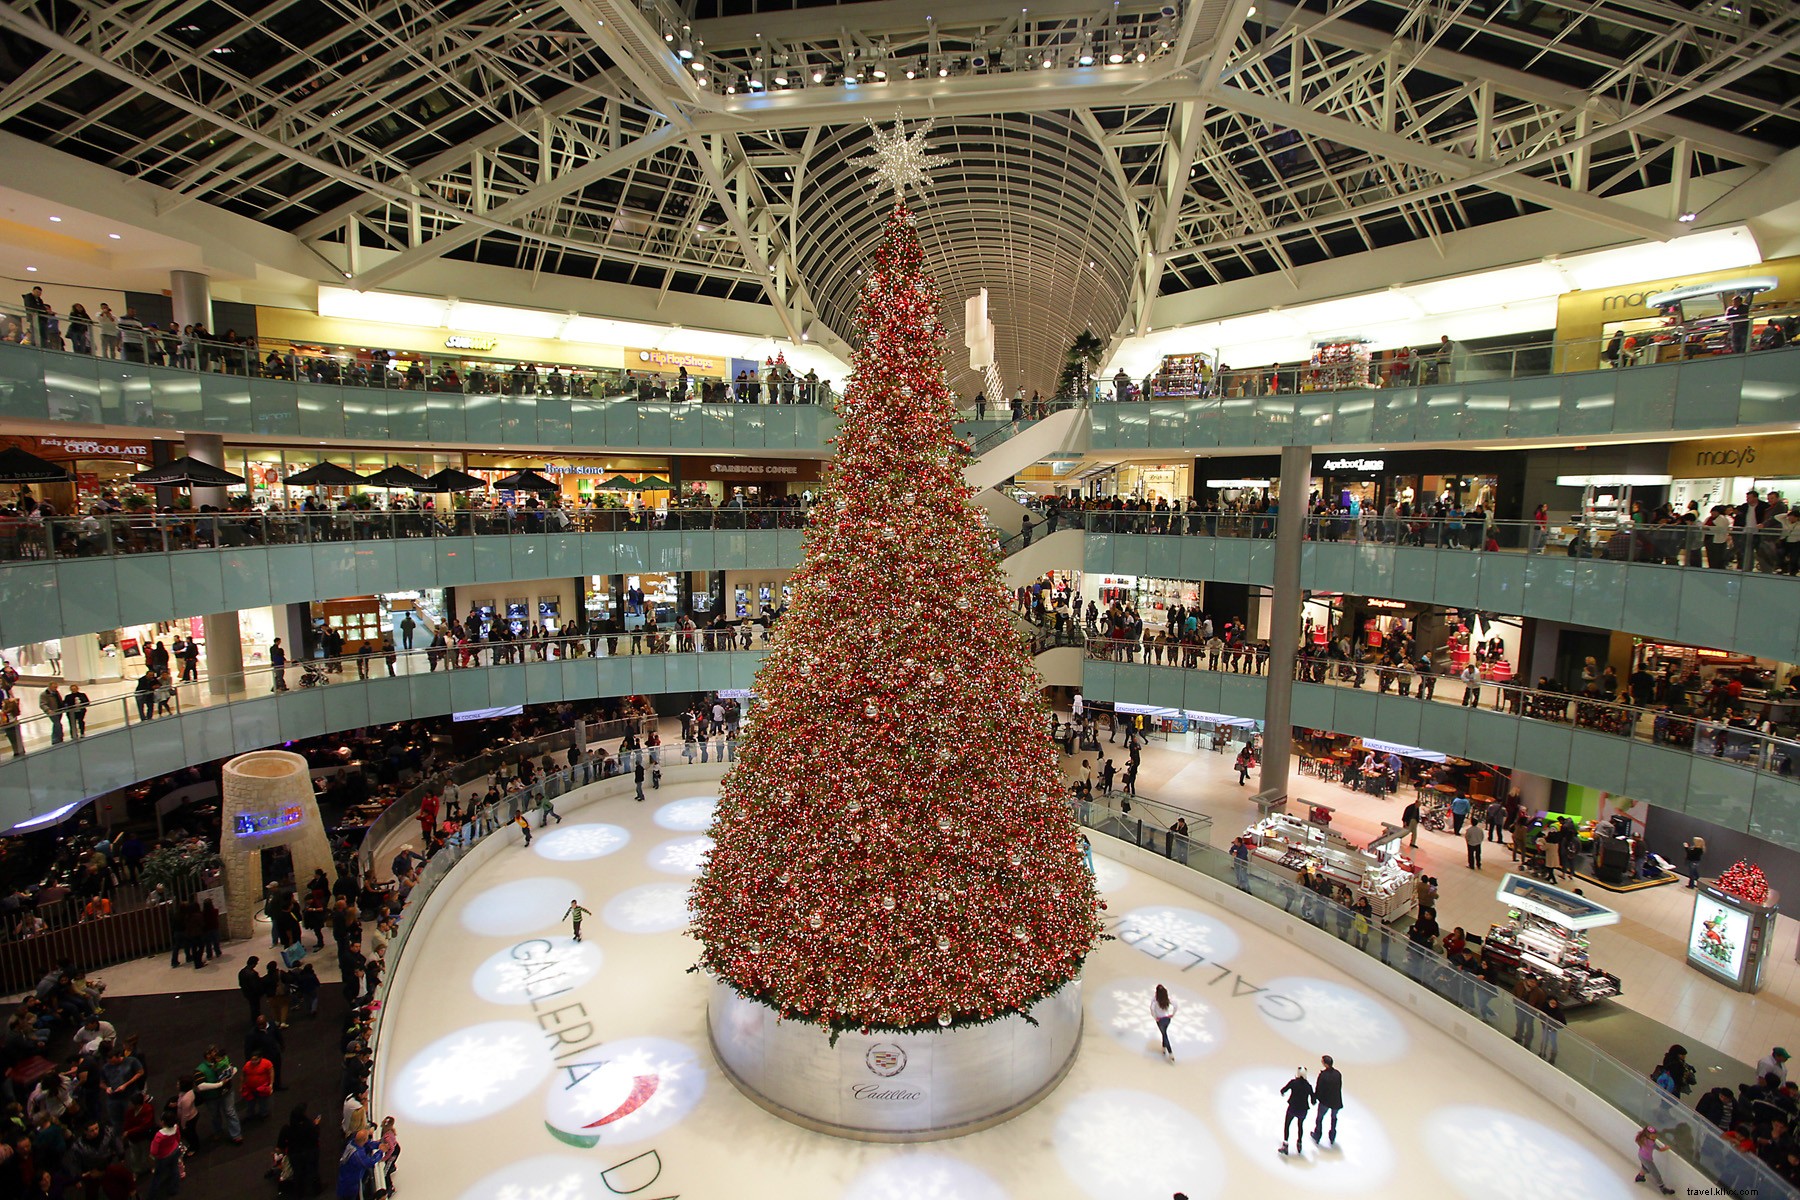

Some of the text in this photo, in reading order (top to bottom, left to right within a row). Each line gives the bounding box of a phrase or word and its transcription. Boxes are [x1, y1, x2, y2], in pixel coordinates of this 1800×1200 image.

[444, 335, 498, 351] SUBWAY
[65, 443, 147, 455] CHOCOLATE
[1696, 445, 1756, 468] macy's
[545, 463, 605, 475] Brookstone
[710, 464, 797, 474] STARBUCKS COFFEE
[1187, 713, 1204, 721] SALAD
[1364, 741, 1384, 750] PANDA
[510, 939, 611, 1091] GALLERIA
[851, 1083, 921, 1100] Cadillac
